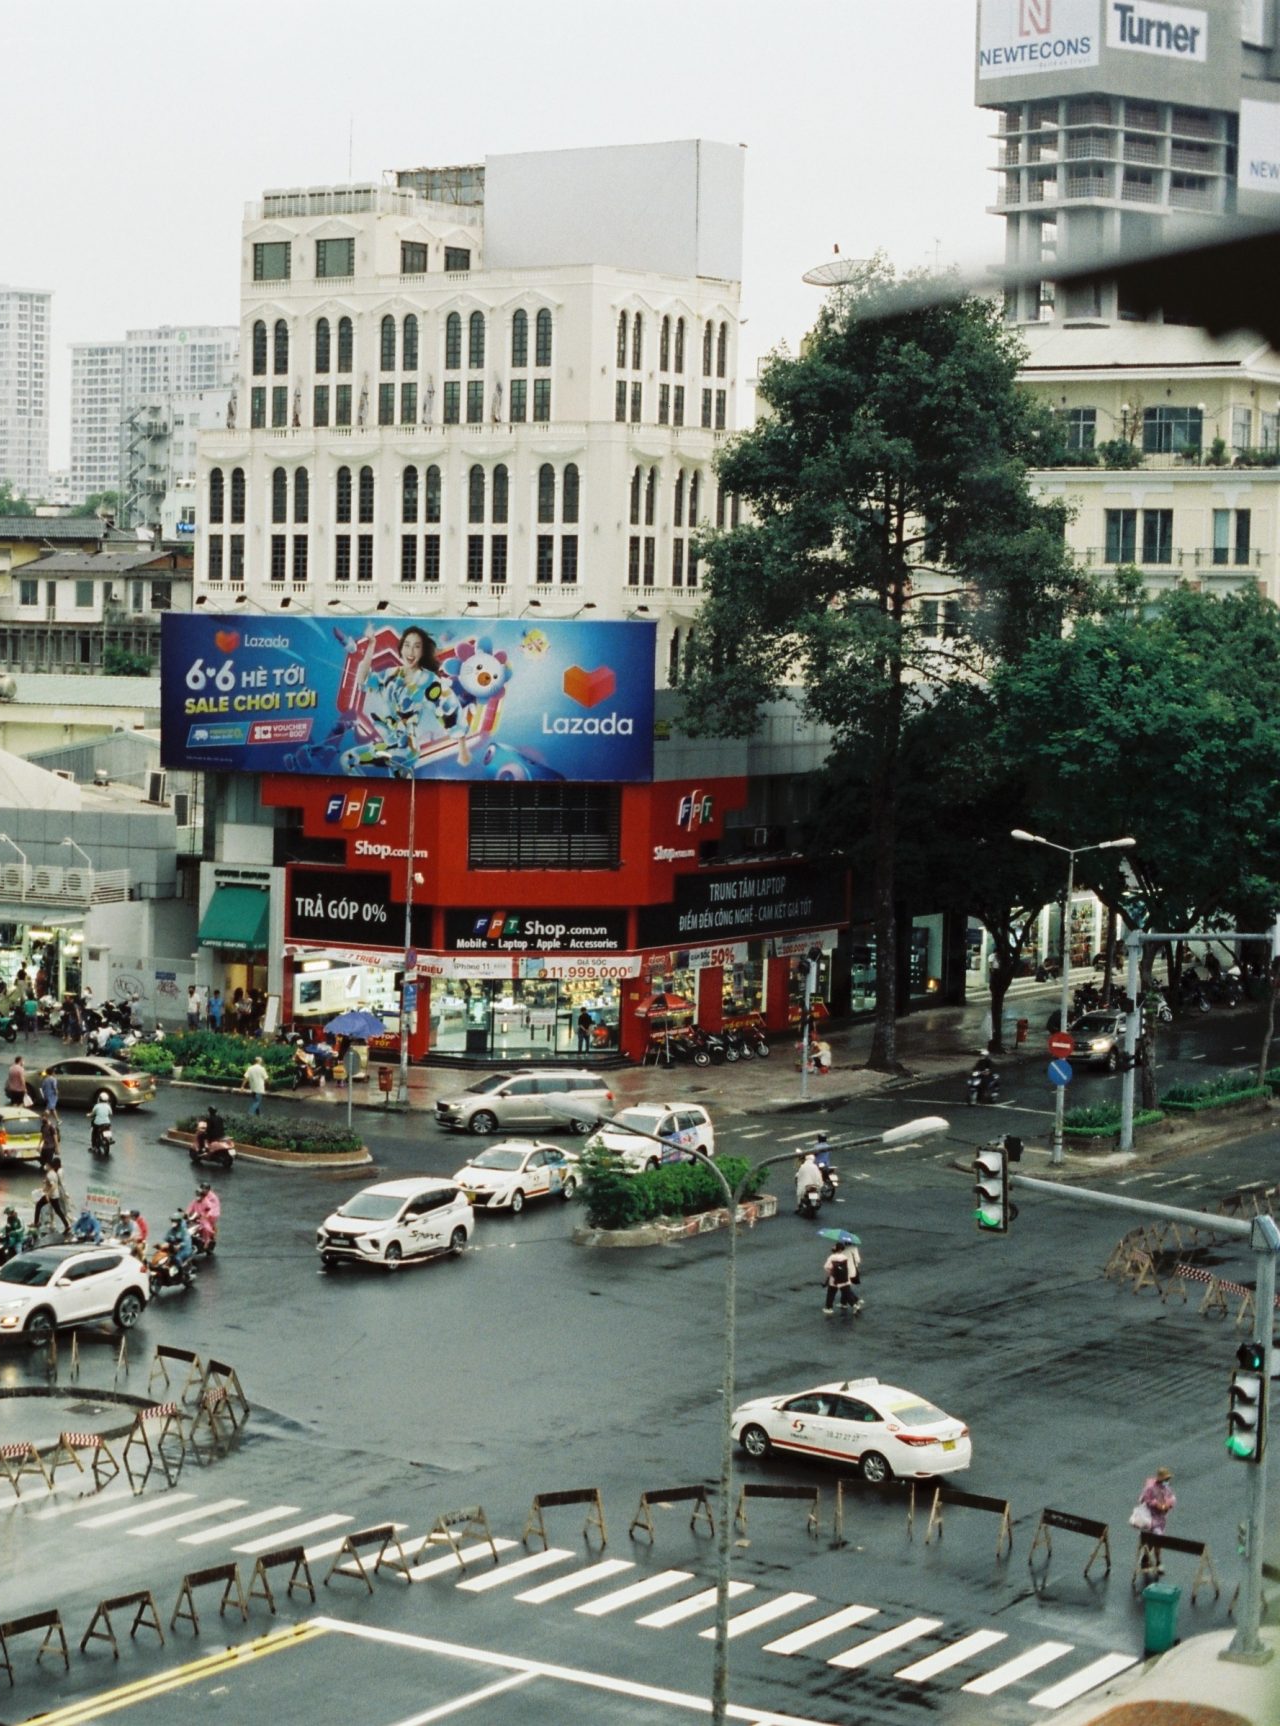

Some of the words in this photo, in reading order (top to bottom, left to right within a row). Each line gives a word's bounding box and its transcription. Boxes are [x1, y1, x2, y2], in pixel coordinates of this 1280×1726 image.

[1113, 3, 1200, 53] Turner
[979, 36, 1091, 66] NEWTECONS
[244, 634, 289, 648] Lazada
[242, 665, 268, 688] HÈ
[273, 663, 305, 686] TỚI
[185, 697, 229, 714] SALE
[234, 692, 280, 711] CHƠI
[285, 687, 317, 709] TỚI
[273, 723, 308, 732] VOUCHER
[542, 712, 633, 735] Lazada
[709, 881, 738, 902] TRUNG
[739, 877, 755, 898] TÂM
[757, 876, 787, 896] LAPTOP
[295, 893, 324, 918] TRẢ
[327, 897, 359, 920] GÓP
[362, 903, 387, 922] 0%
[679, 908, 698, 931] ĐIỂM
[699, 907, 714, 929] ĐẾN
[714, 906, 734, 926] CÔNG
[734, 904, 753, 927] NGHỆ
[758, 905, 773, 922] CAM
[456, 938, 487, 948] Mobile
[498, 938, 528, 950] Laptop
[536, 938, 561, 950] Apple
[570, 938, 618, 949] Accessories
[711, 947, 735, 965] 50%
